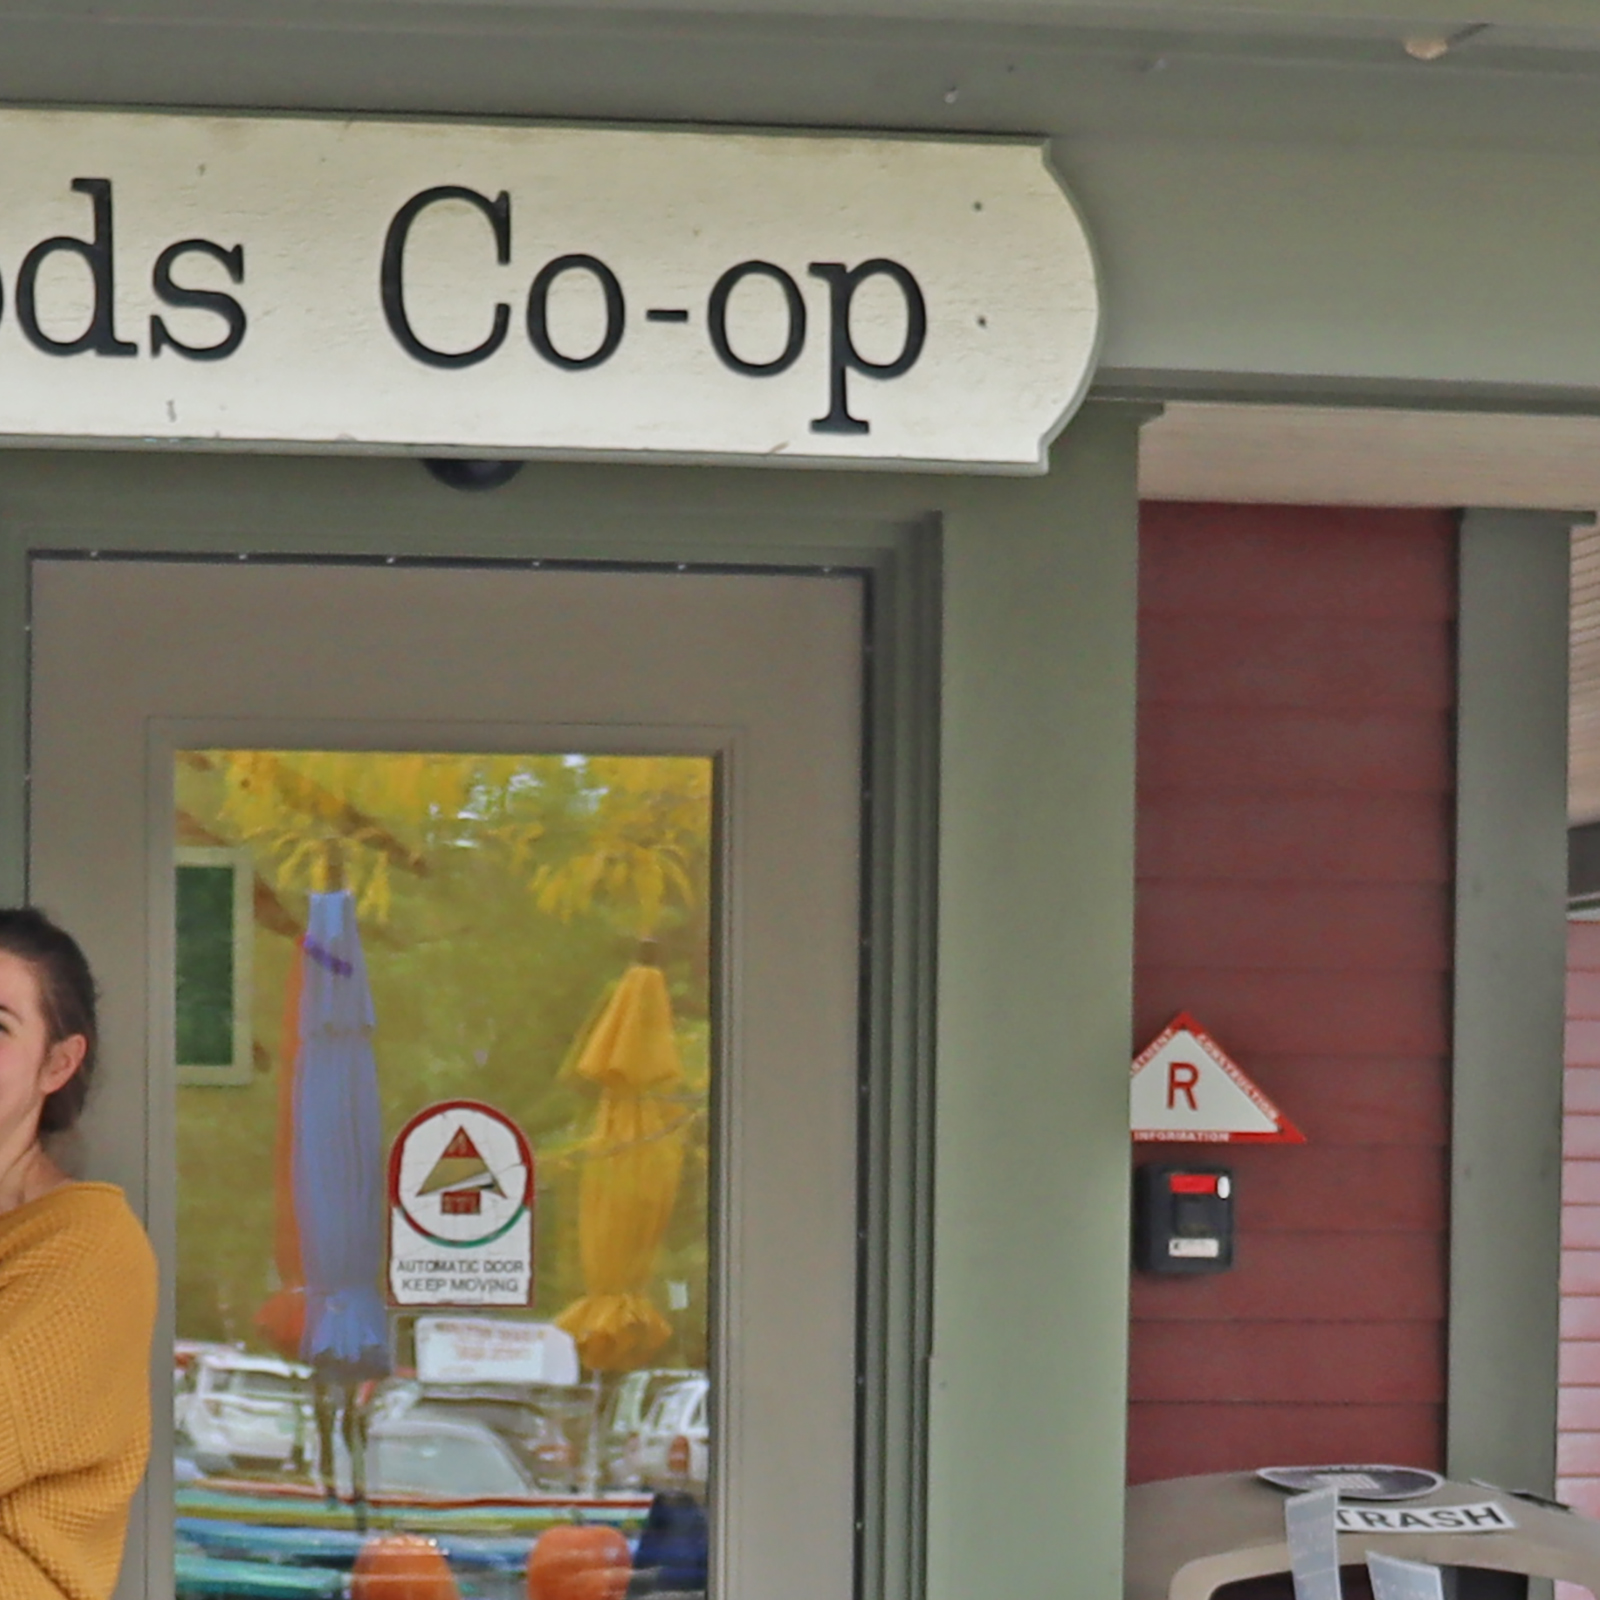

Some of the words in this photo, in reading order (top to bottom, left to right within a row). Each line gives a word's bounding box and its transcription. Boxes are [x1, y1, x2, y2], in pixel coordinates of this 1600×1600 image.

[381, 186, 926, 433] Co-op
[1167, 1061, 1199, 1112] R
[1133, 1132, 1230, 1142] INFORMATION
[396, 1260, 481, 1273] AUTOMATIC
[483, 1260, 524, 1273] DOOR
[401, 1278, 446, 1292] KEEP
[450, 1278, 519, 1293] MOVING
